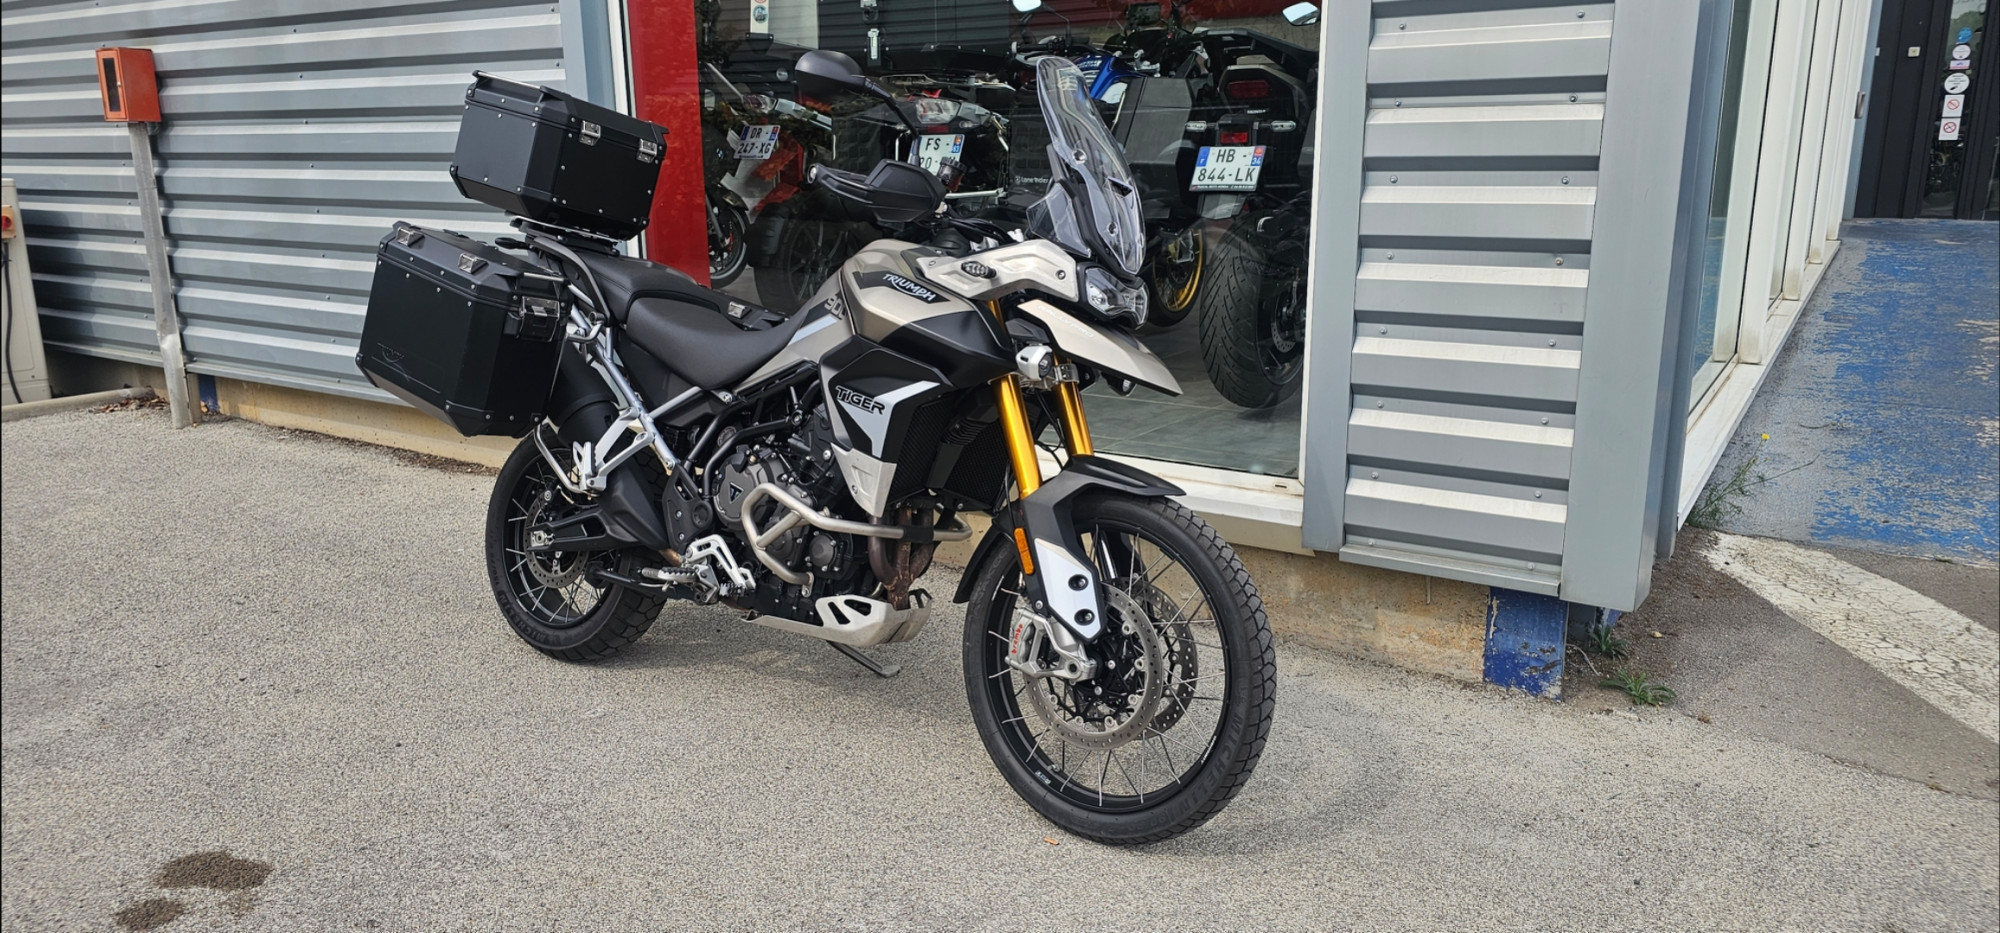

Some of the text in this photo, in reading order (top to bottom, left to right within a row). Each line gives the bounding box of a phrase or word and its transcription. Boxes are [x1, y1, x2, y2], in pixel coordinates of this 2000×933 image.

[925, 138, 941, 151] FS
[1216, 149, 1236, 163] HB
[1197, 168, 1256, 182] 844-LK
[882, 273, 937, 301] TRIUMPH
[835, 385, 886, 416] TIGER
[1011, 623, 1024, 655] brembo
[1180, 712, 1244, 814] MICHELIN
